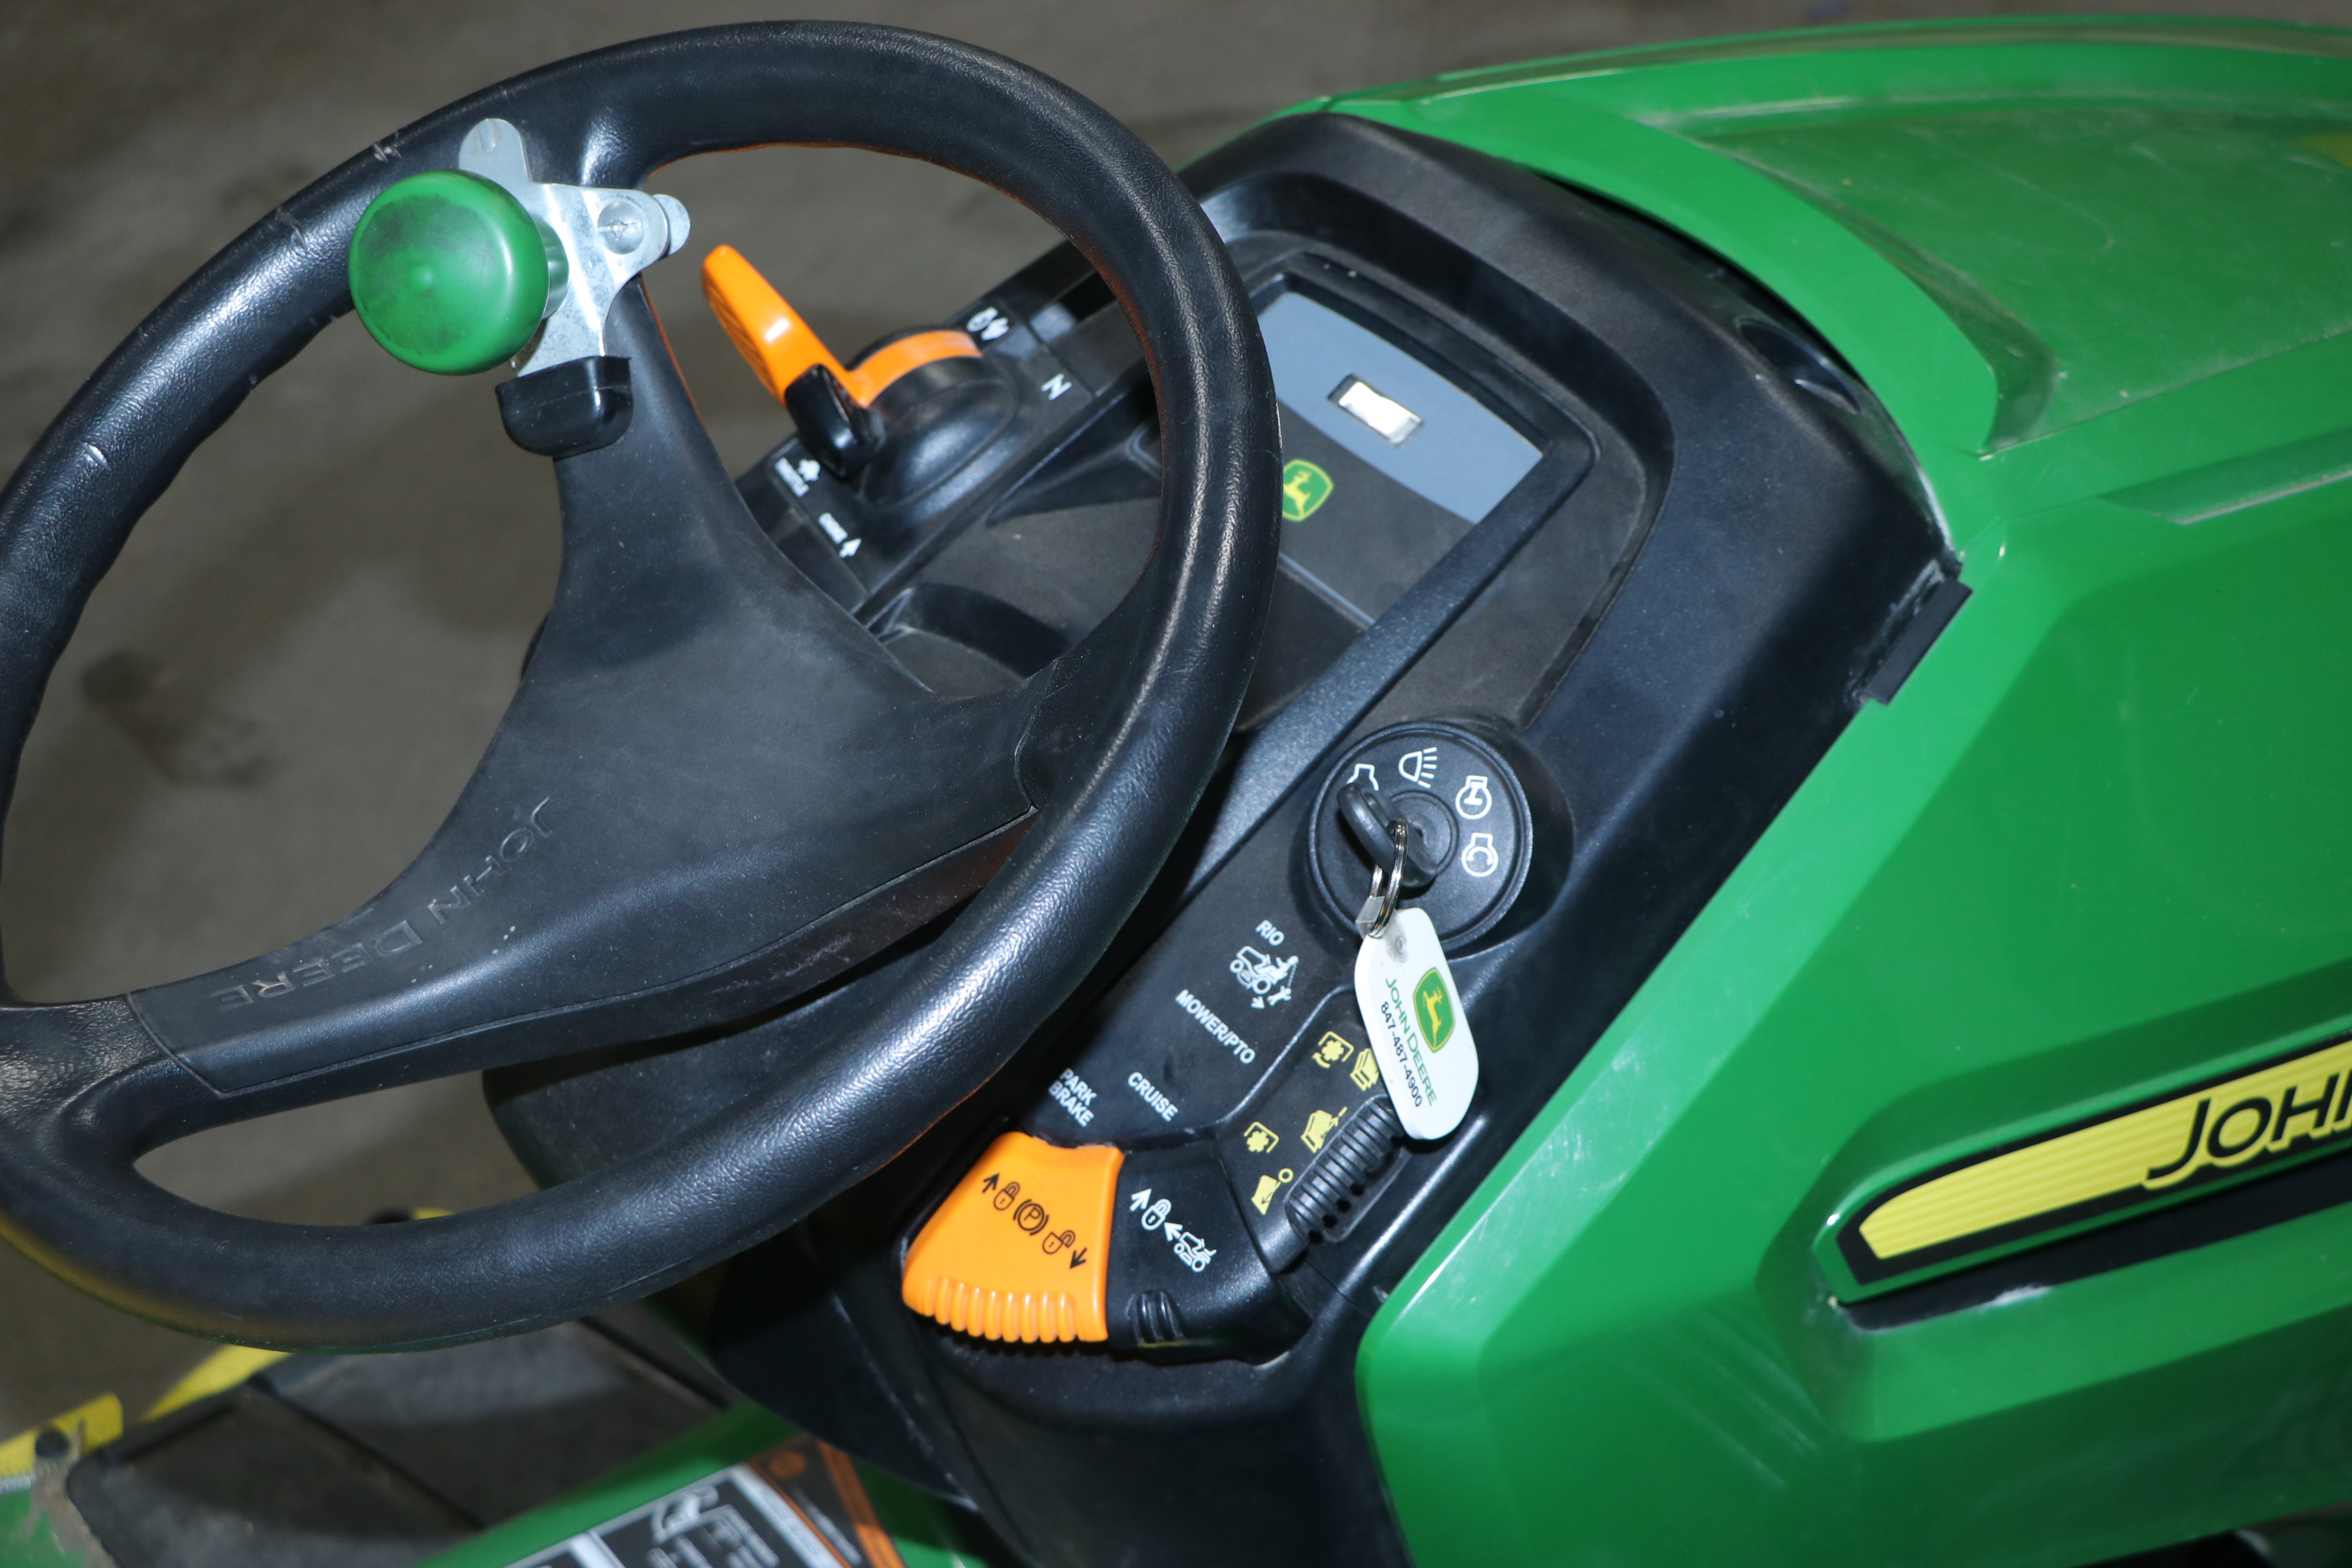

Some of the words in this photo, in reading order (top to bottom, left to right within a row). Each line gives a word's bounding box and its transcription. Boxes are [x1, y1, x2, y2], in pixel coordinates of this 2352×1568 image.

[427, 796, 553, 925] JOHN
[210, 920, 423, 1011] DEERE
[1255, 920, 1285, 946] RIO
[1175, 989, 1256, 1064] MOWER/PTO
[1381, 1001, 1422, 1107] 847-487-4900
[1385, 978, 1411, 1034] JOHN
[1407, 1032, 1437, 1106] DEERE
[1047, 1080, 1094, 1127] BRAKE
[1060, 1068, 1097, 1106] PARK
[1127, 1072, 1178, 1121] CRUISE
